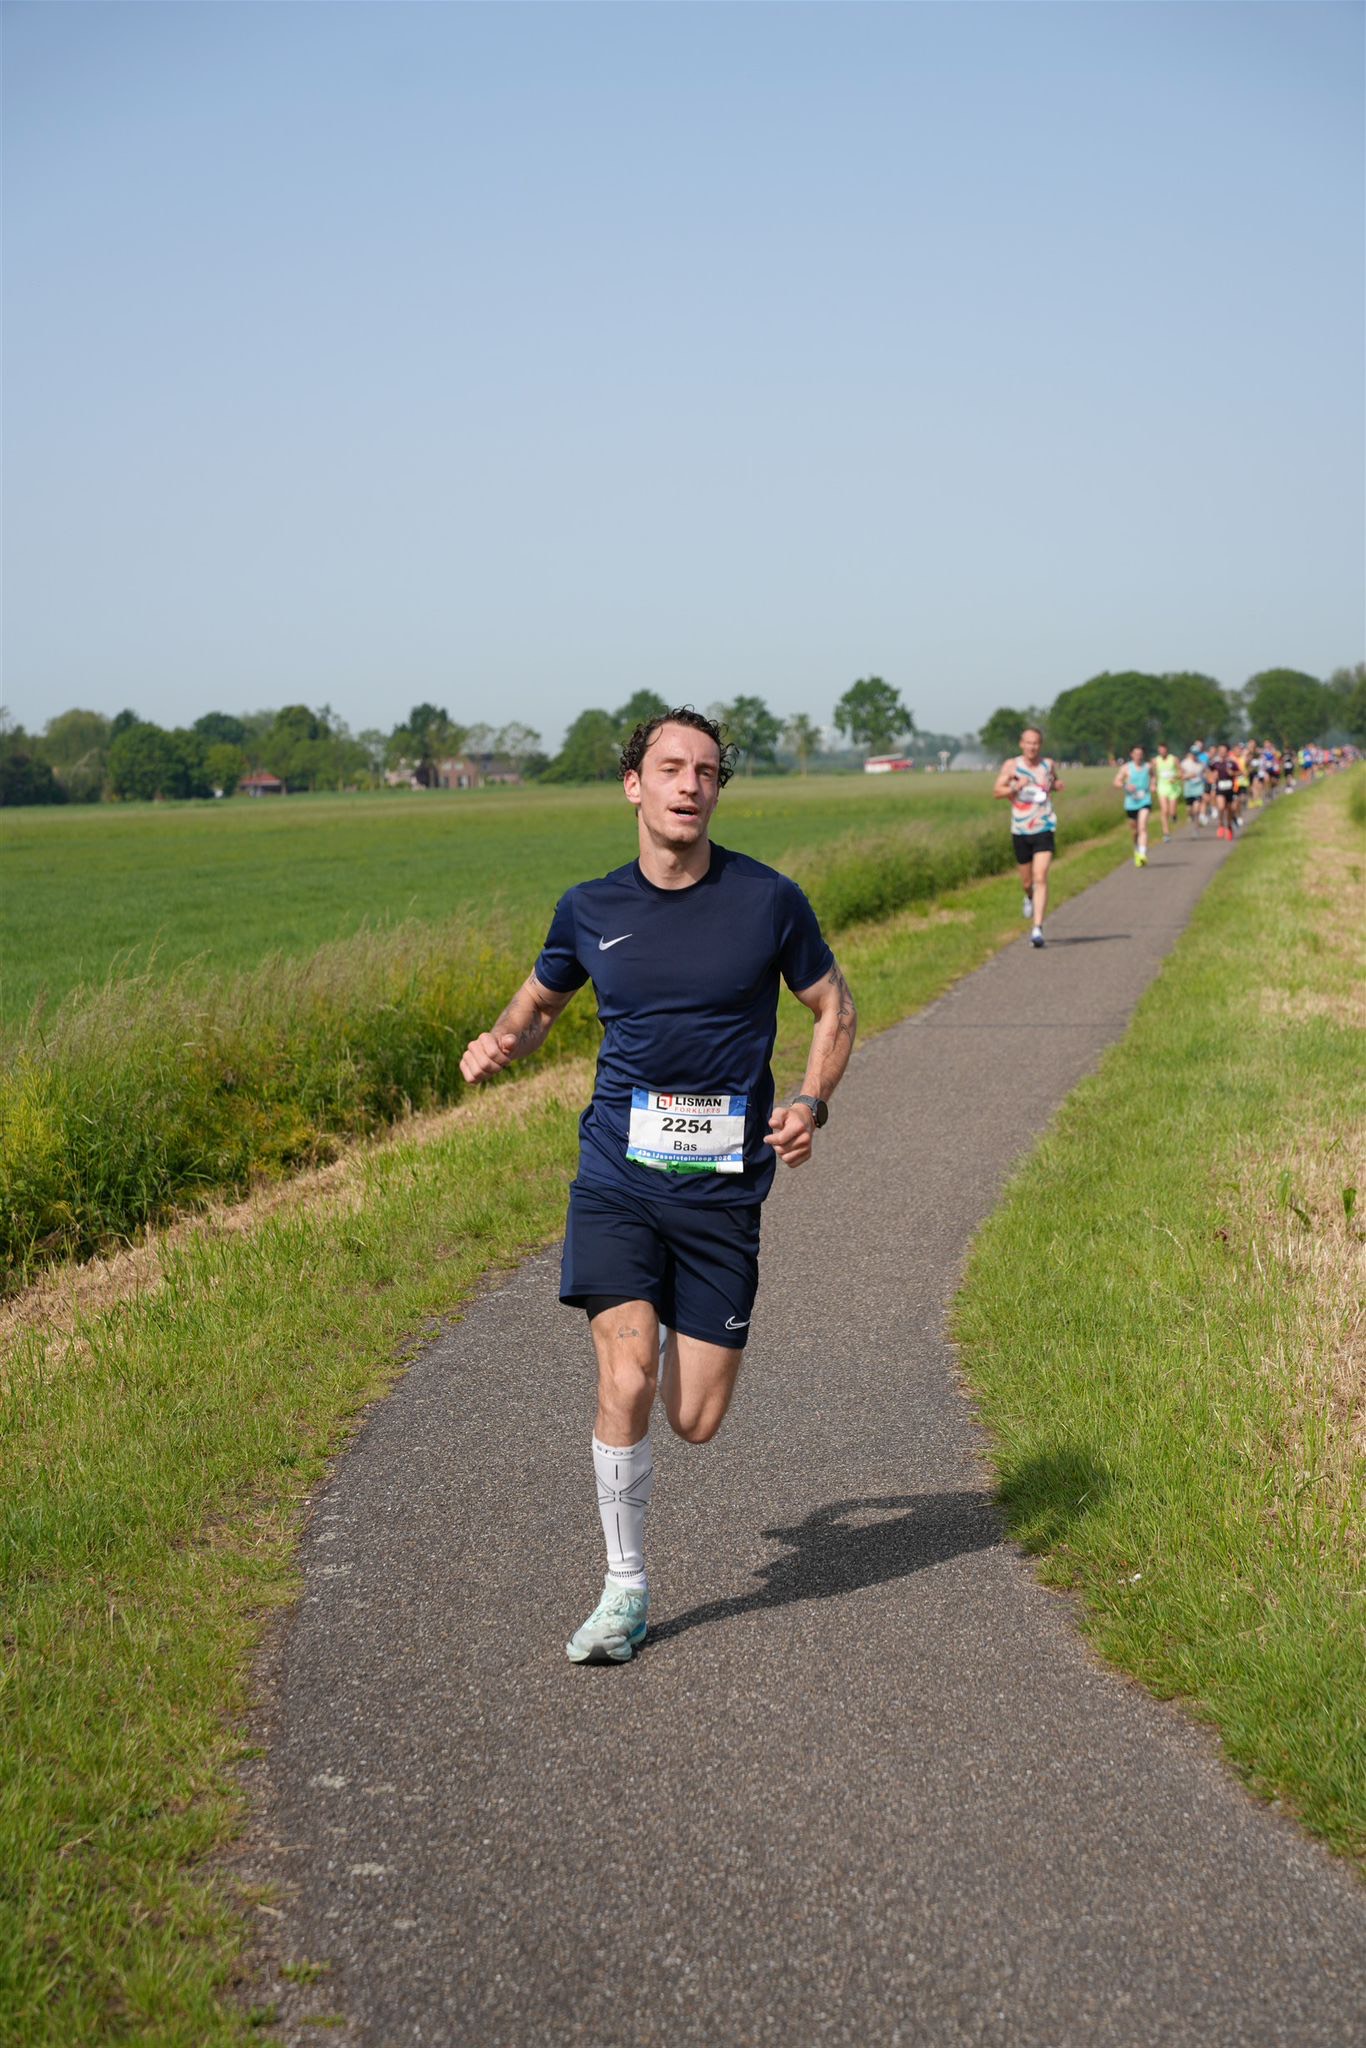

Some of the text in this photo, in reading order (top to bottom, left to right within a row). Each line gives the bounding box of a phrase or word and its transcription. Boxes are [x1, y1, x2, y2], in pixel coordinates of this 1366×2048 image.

[675, 1096, 722, 1107] LISMAN
[674, 1106, 721, 1114] FORKLIFTS
[661, 1117, 712, 1134] 2254
[673, 1140, 697, 1152] Bas
